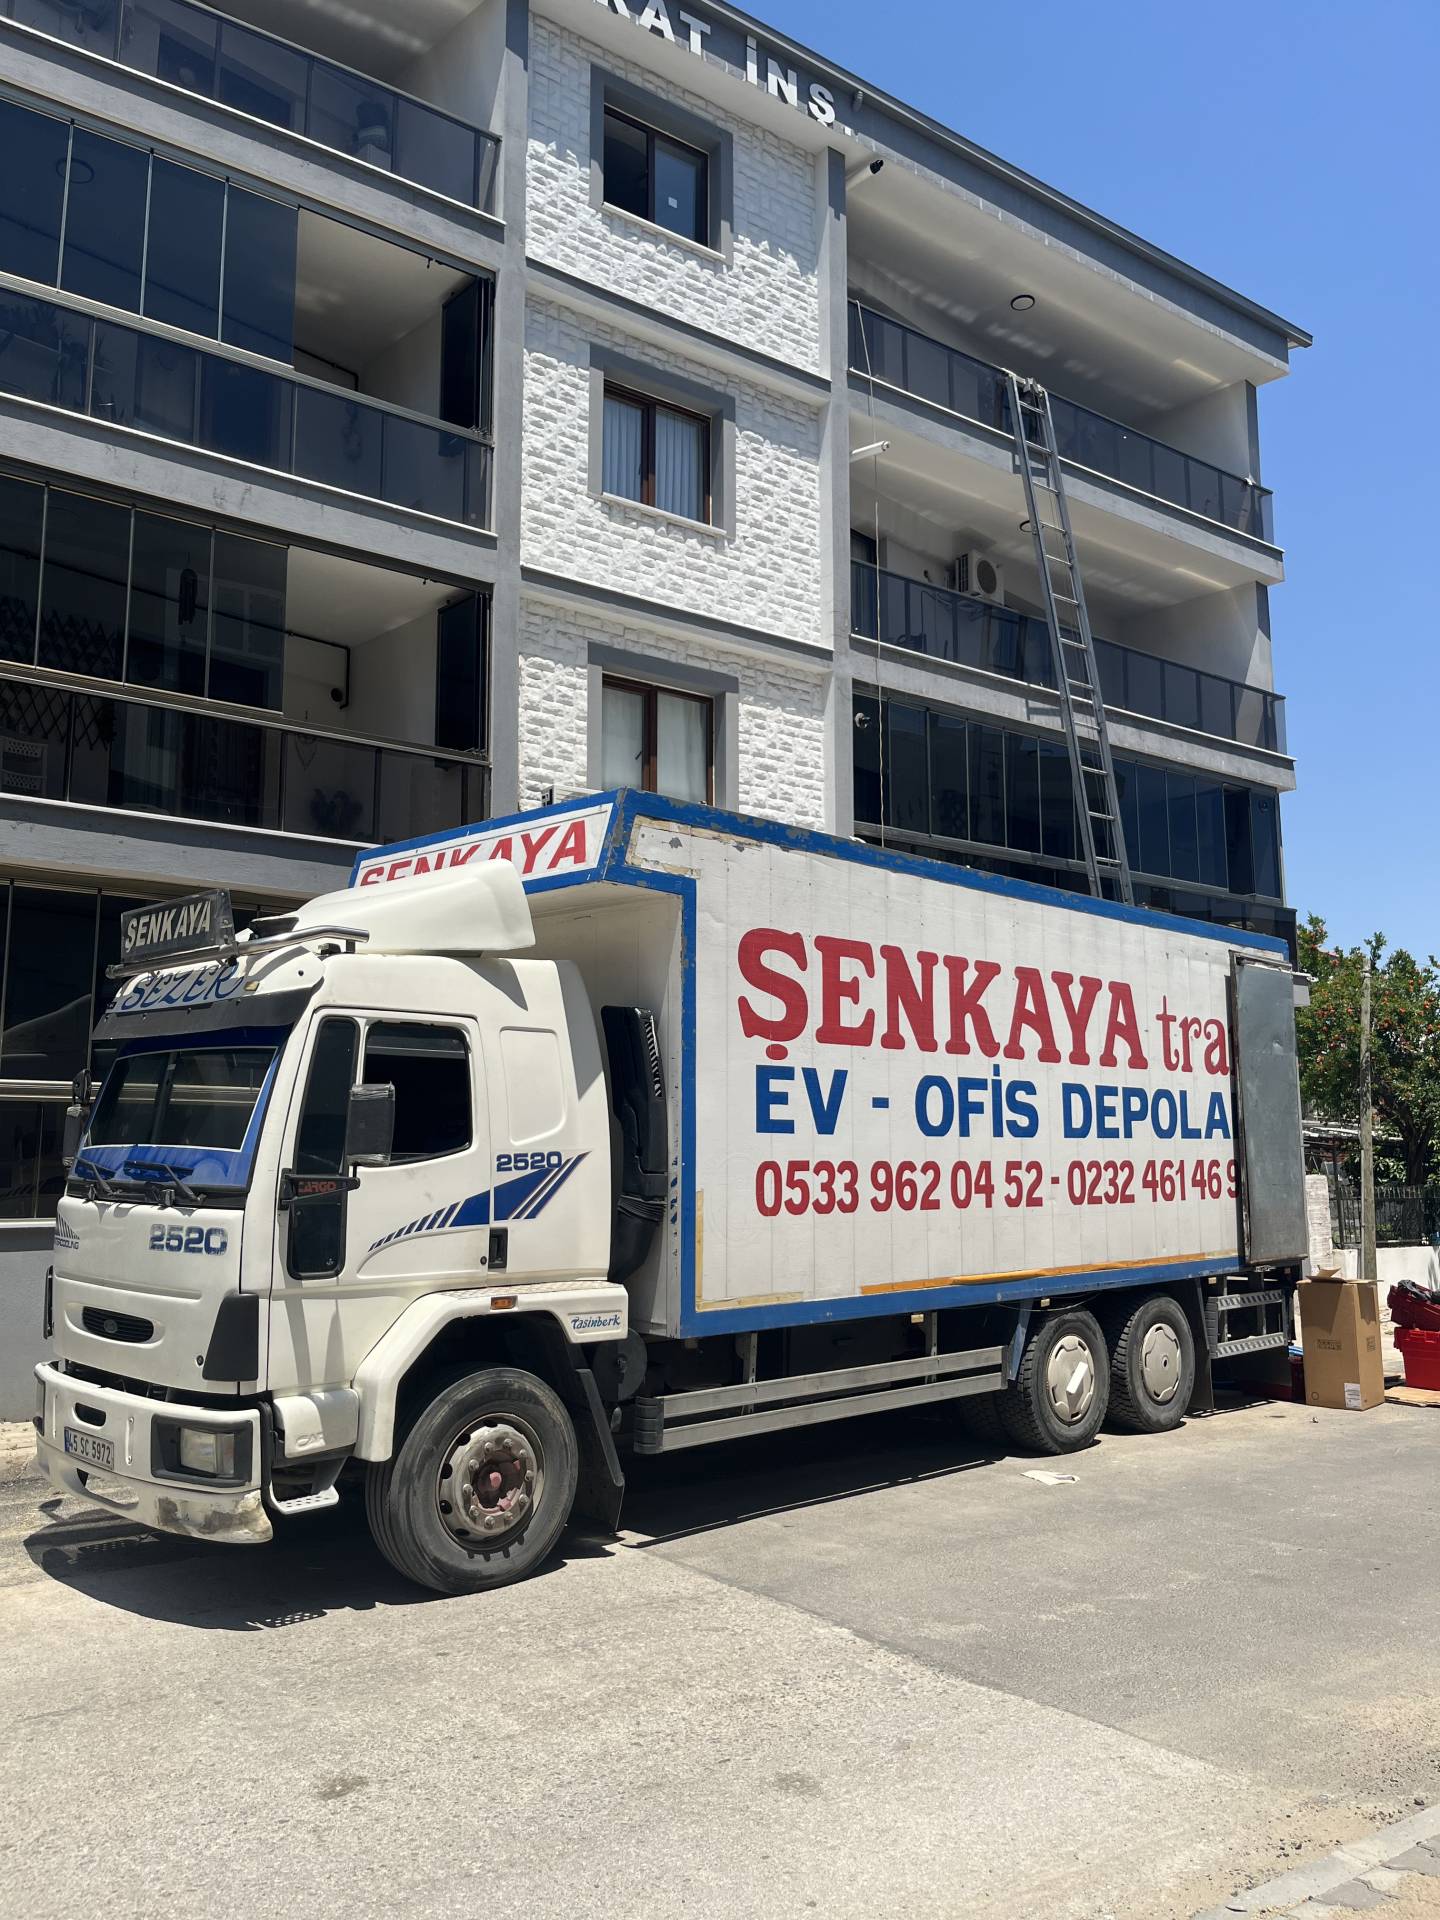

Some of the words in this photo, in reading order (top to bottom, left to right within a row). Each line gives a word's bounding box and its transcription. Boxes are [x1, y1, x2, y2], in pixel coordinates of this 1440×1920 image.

[737, 928, 1148, 1070] ŞENKAYA
[1155, 995, 1235, 1075] tra
[756, 1064, 849, 1135] EV
[871, 1096, 890, 1109] -
[915, 1064, 1039, 1138] OFİS
[1061, 1082, 1237, 1140] DEPOLA
[496, 1150, 563, 1172] 2520
[298, 1181, 337, 1195] CARGO
[755, 1159, 859, 1217] 0533
[870, 1159, 941, 1212] 962
[950, 1159, 995, 1209] 04
[1004, 1159, 1044, 1208] 52
[1067, 1159, 1135, 1206] 0232
[1142, 1159, 1187, 1203] 461
[149, 1223, 229, 1256] 2520
[80, 1437, 90, 1457] SC
[91, 1441, 111, 1465] 5972
